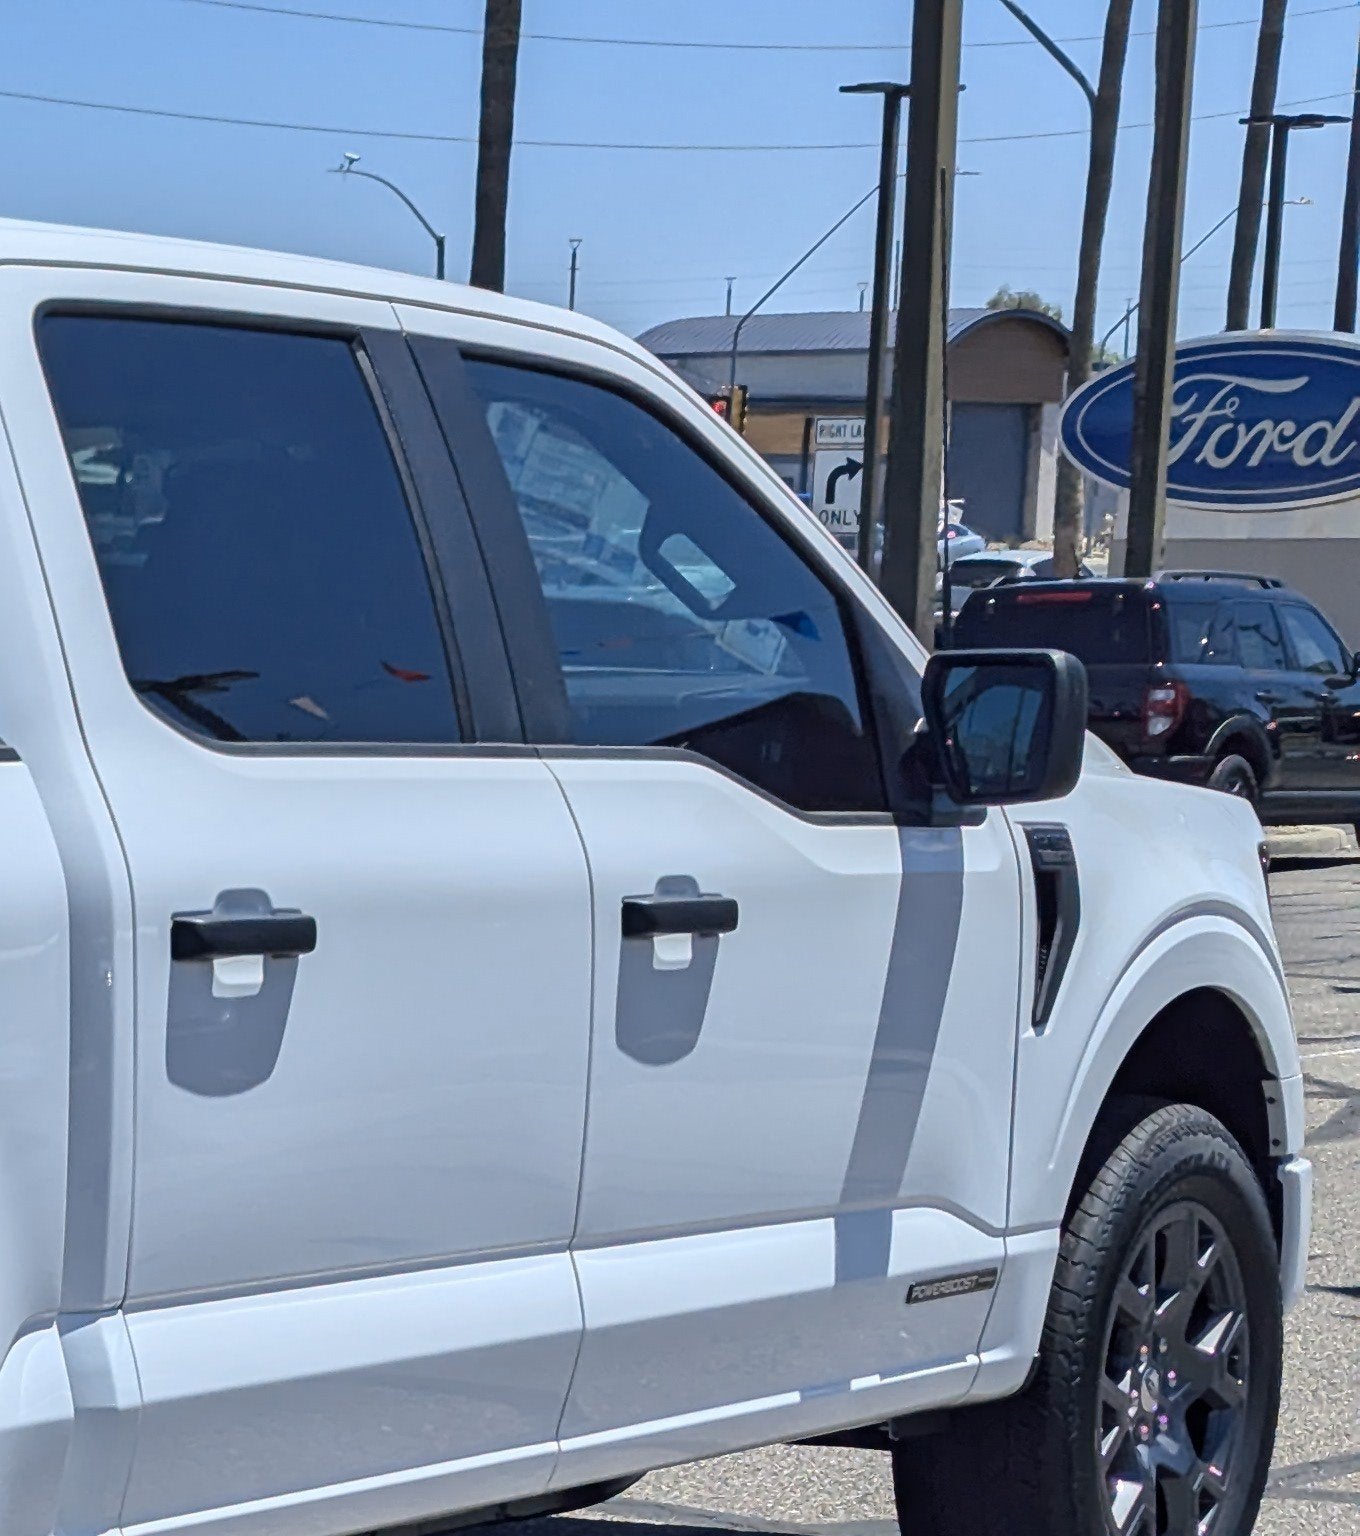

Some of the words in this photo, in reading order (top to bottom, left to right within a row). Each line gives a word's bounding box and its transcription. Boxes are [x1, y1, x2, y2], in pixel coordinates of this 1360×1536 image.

[1166, 373, 1360, 469] Ford
[818, 423, 848, 439] RIGHT
[850, 423, 863, 438] LA
[818, 509, 863, 526] ONLY
